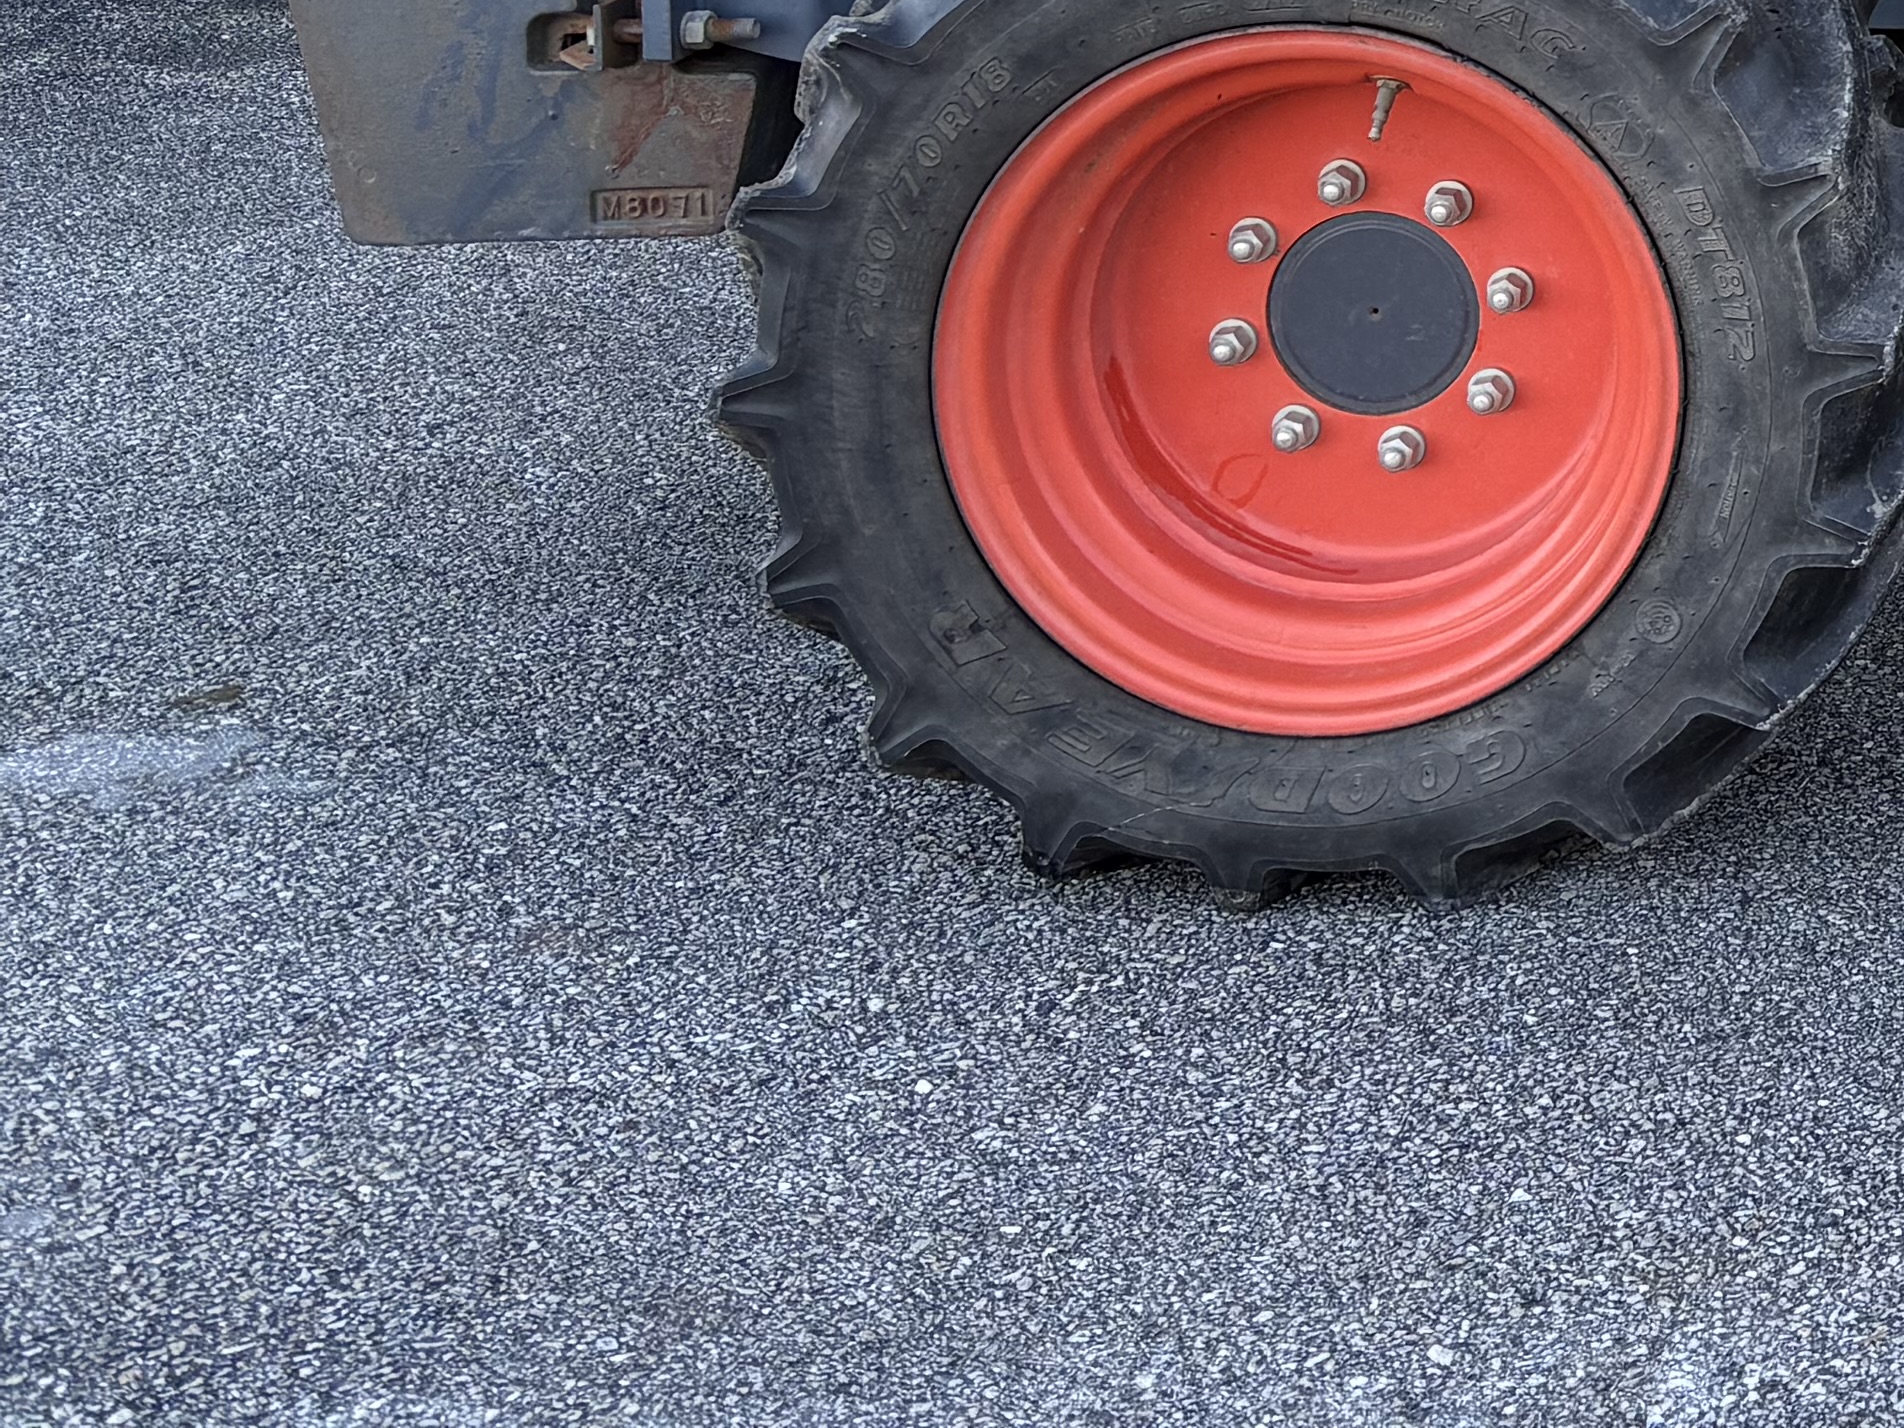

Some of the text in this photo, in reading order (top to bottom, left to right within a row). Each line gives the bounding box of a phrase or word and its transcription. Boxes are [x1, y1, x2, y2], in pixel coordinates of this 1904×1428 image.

[600, 191, 710, 222] M8071
[1674, 184, 1756, 363] DT812
[929, 599, 1528, 815] GOODYEAR
